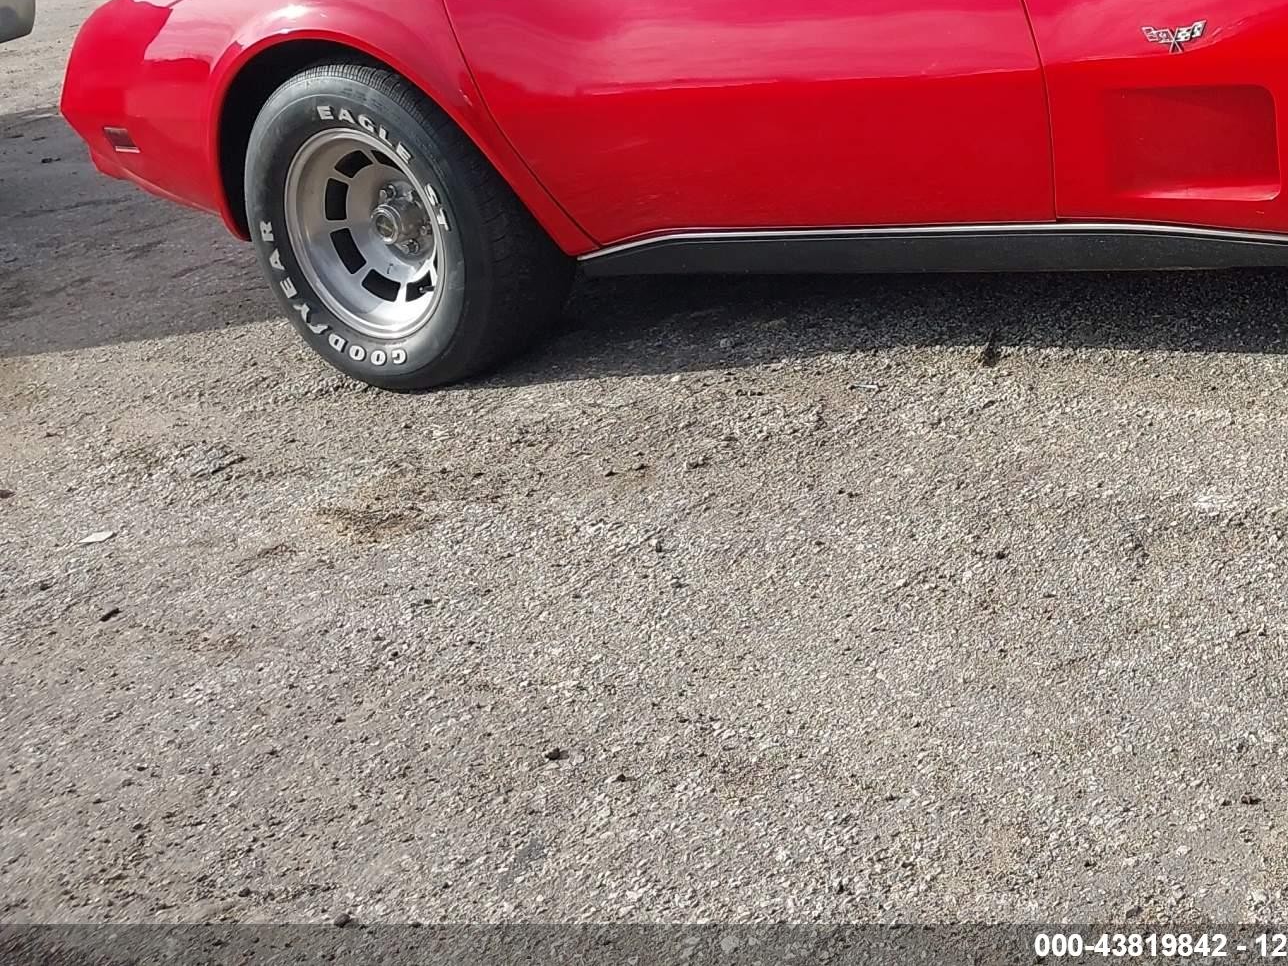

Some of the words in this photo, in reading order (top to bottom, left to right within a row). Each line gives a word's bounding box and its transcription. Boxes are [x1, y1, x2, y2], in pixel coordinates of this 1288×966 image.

[317, 105, 412, 164] EAGLE
[424, 183, 450, 231] ST
[259, 220, 407, 366] GOODYEAR
